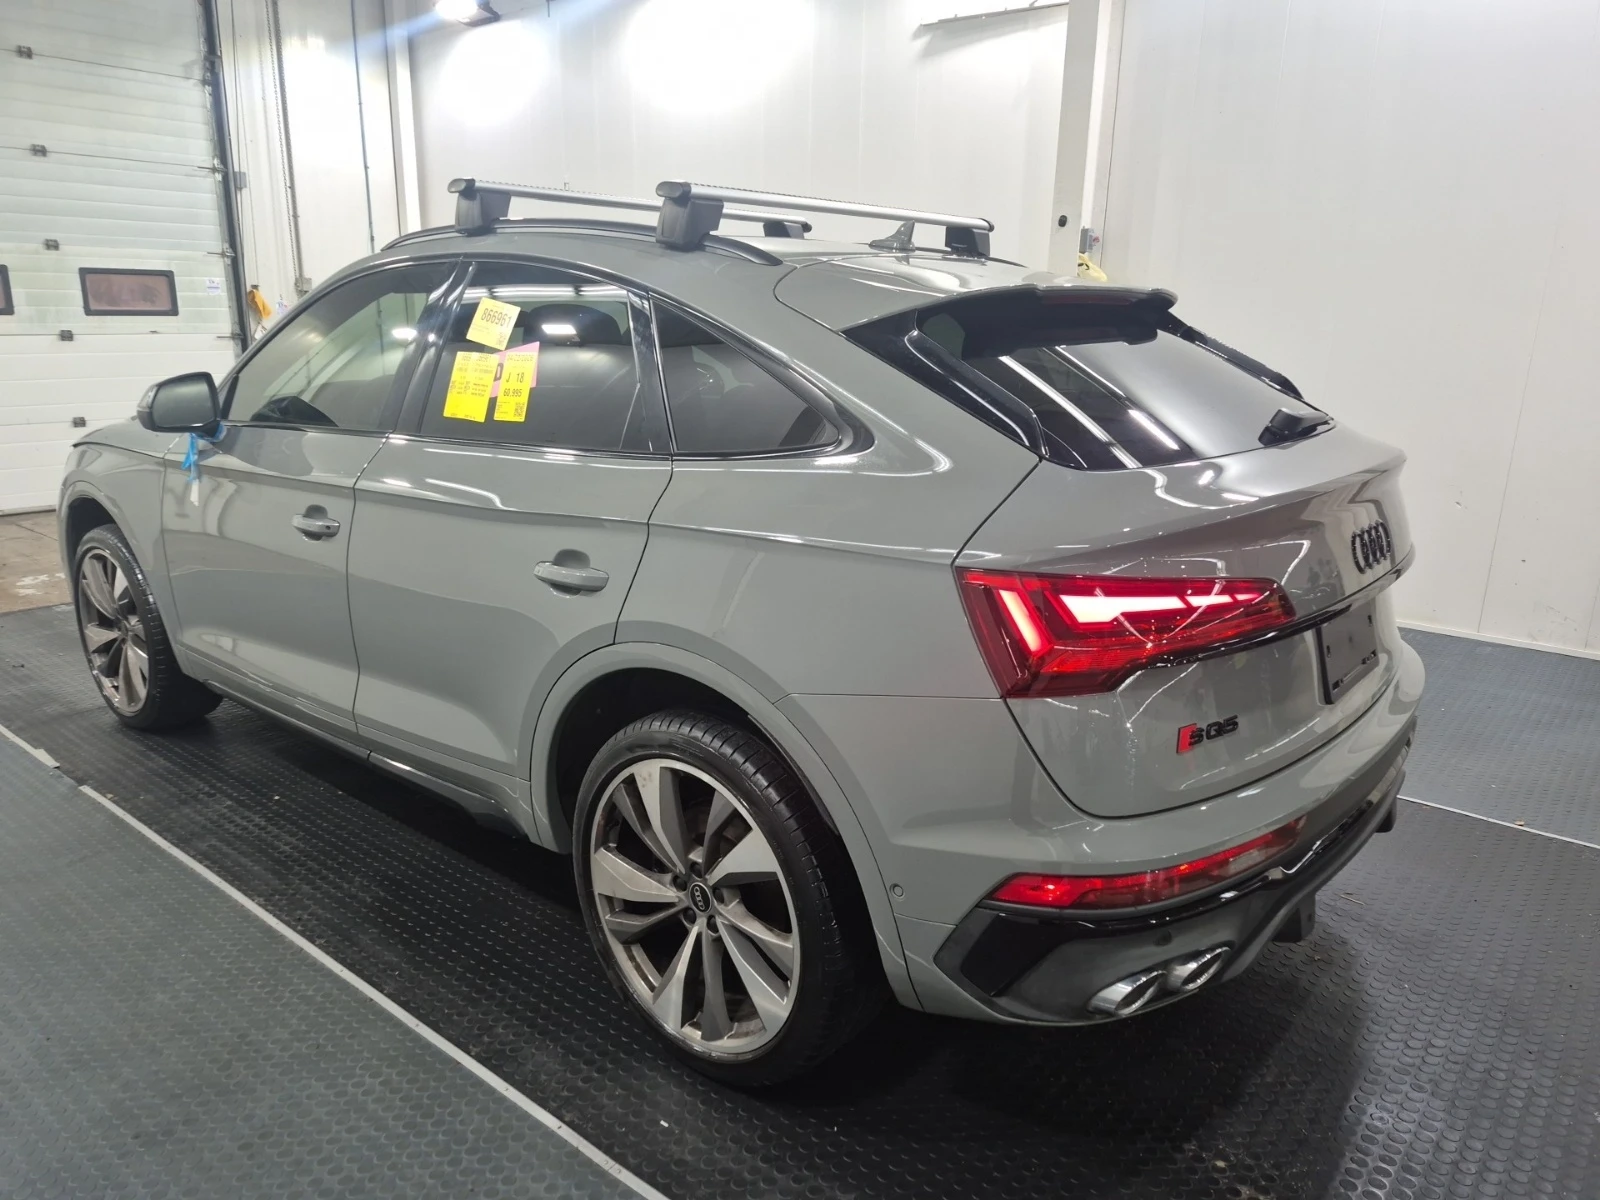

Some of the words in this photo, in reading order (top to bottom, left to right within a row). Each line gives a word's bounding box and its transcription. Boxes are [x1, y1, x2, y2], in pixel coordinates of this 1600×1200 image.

[480, 308, 513, 328] 866961
[516, 372, 525, 383] 18
[1187, 714, 1239, 747] SQ5
